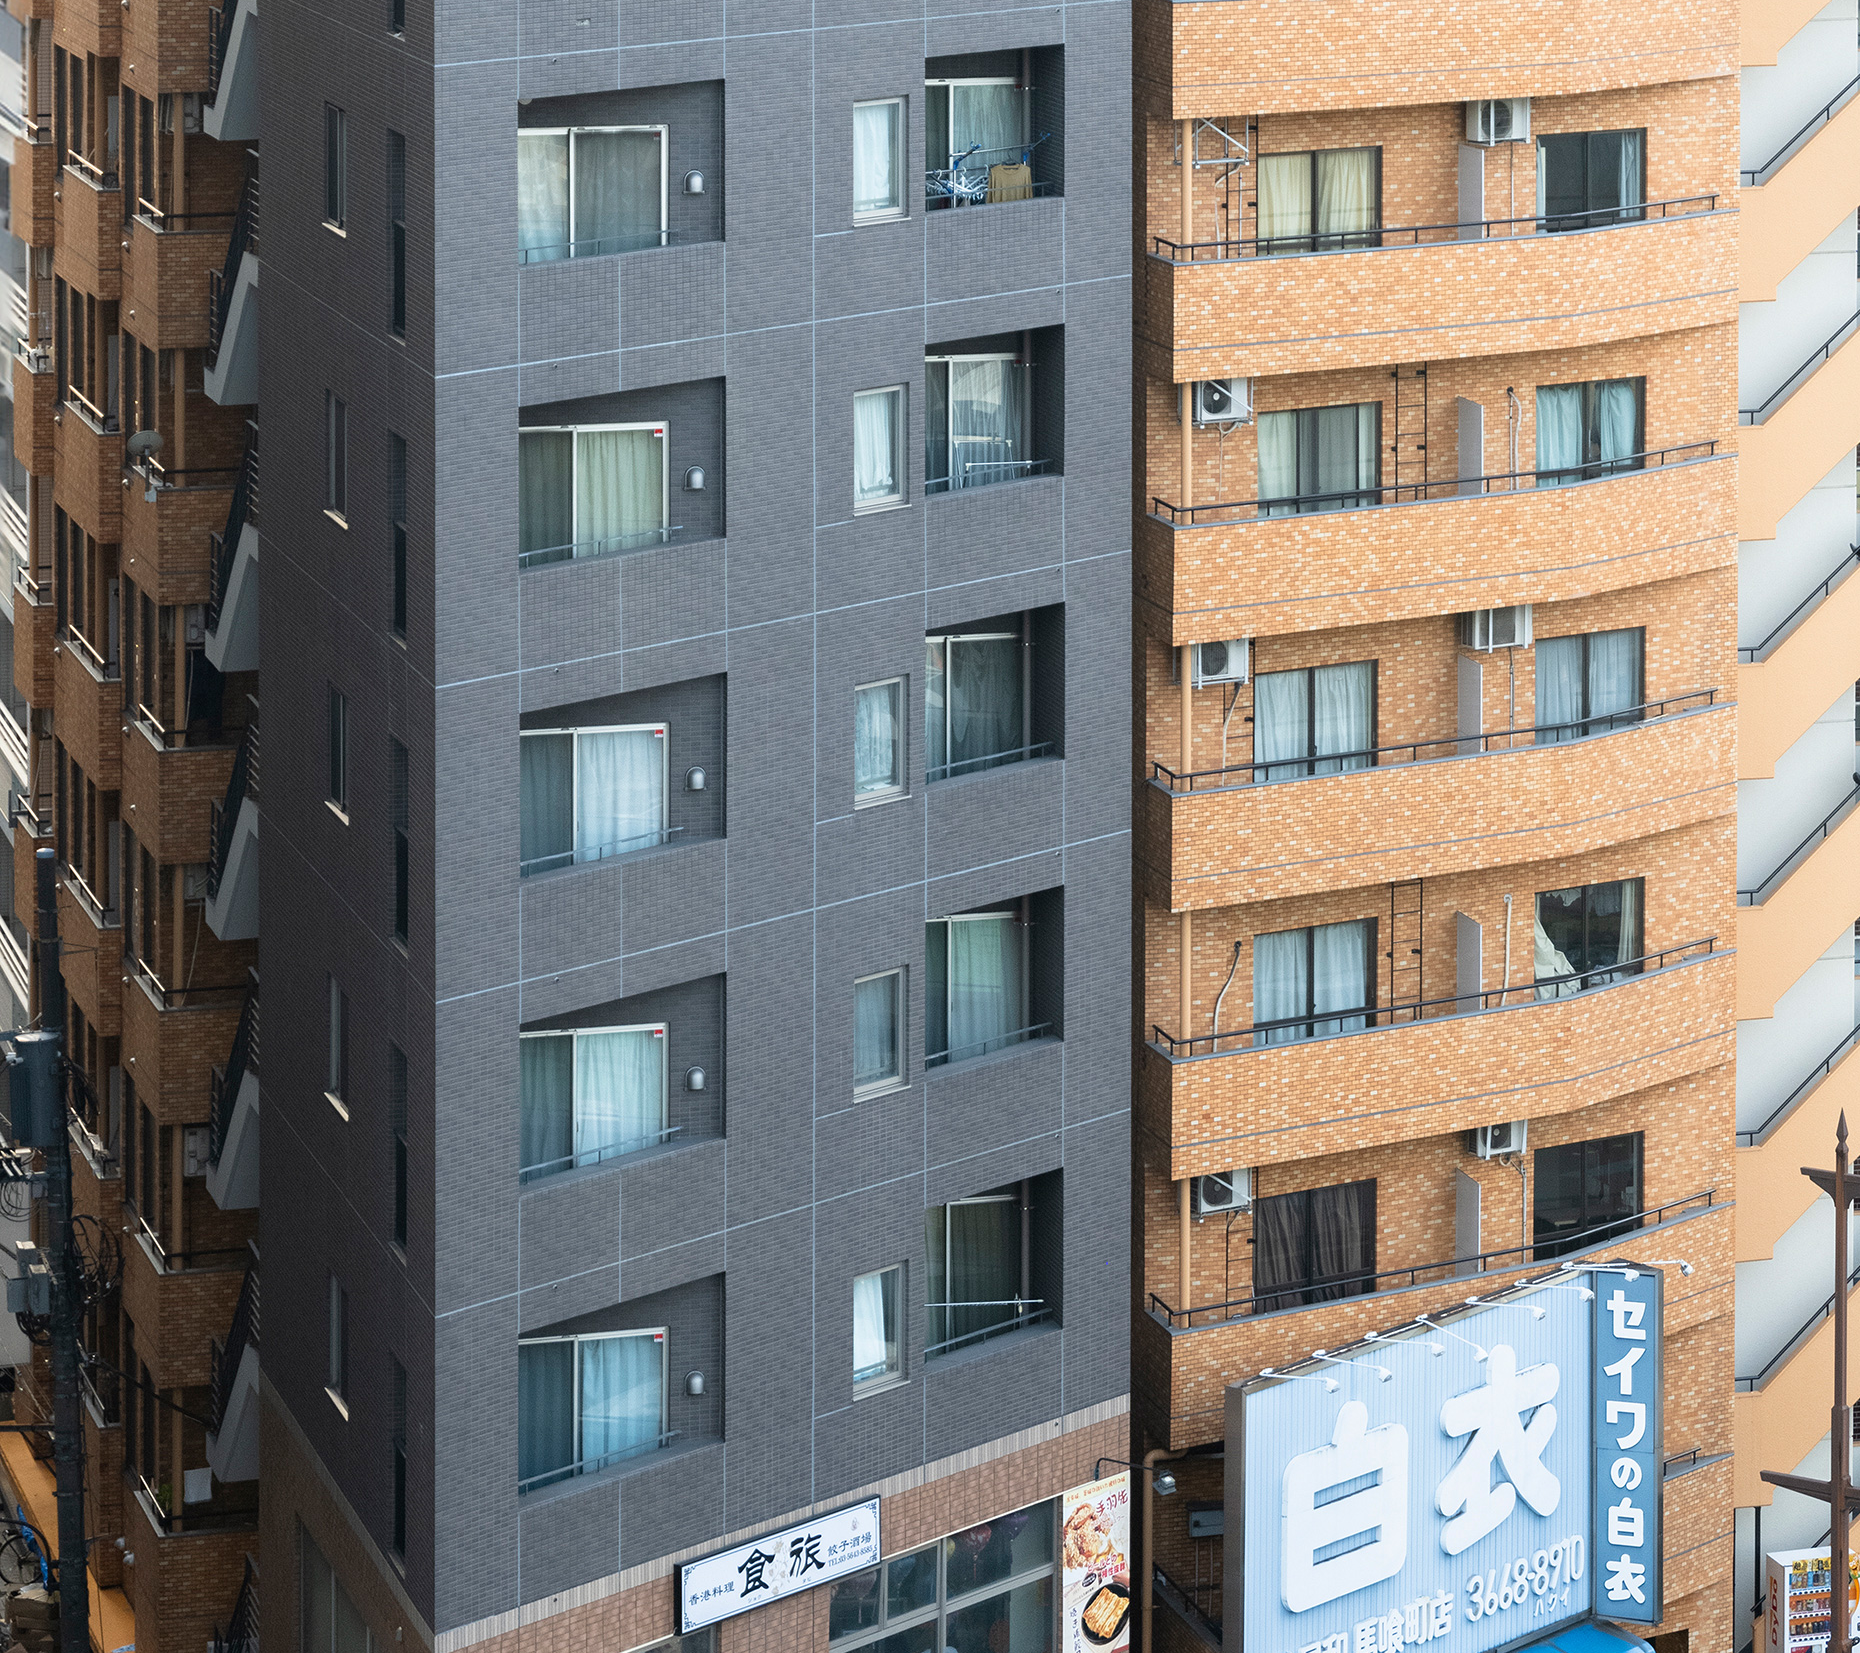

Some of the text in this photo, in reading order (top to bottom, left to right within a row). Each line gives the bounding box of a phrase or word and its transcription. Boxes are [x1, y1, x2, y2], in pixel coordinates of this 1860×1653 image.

[1603, 1289, 1648, 1604] セイワの白衣
[1281, 1344, 1561, 1613] 白衣
[827, 1531, 872, 1557] 餃子酒場
[688, 1580, 735, 1606] 香港料理
[1465, 1534, 1585, 1622] 3668-8910
[1533, 1586, 1570, 1618] ハクイ
